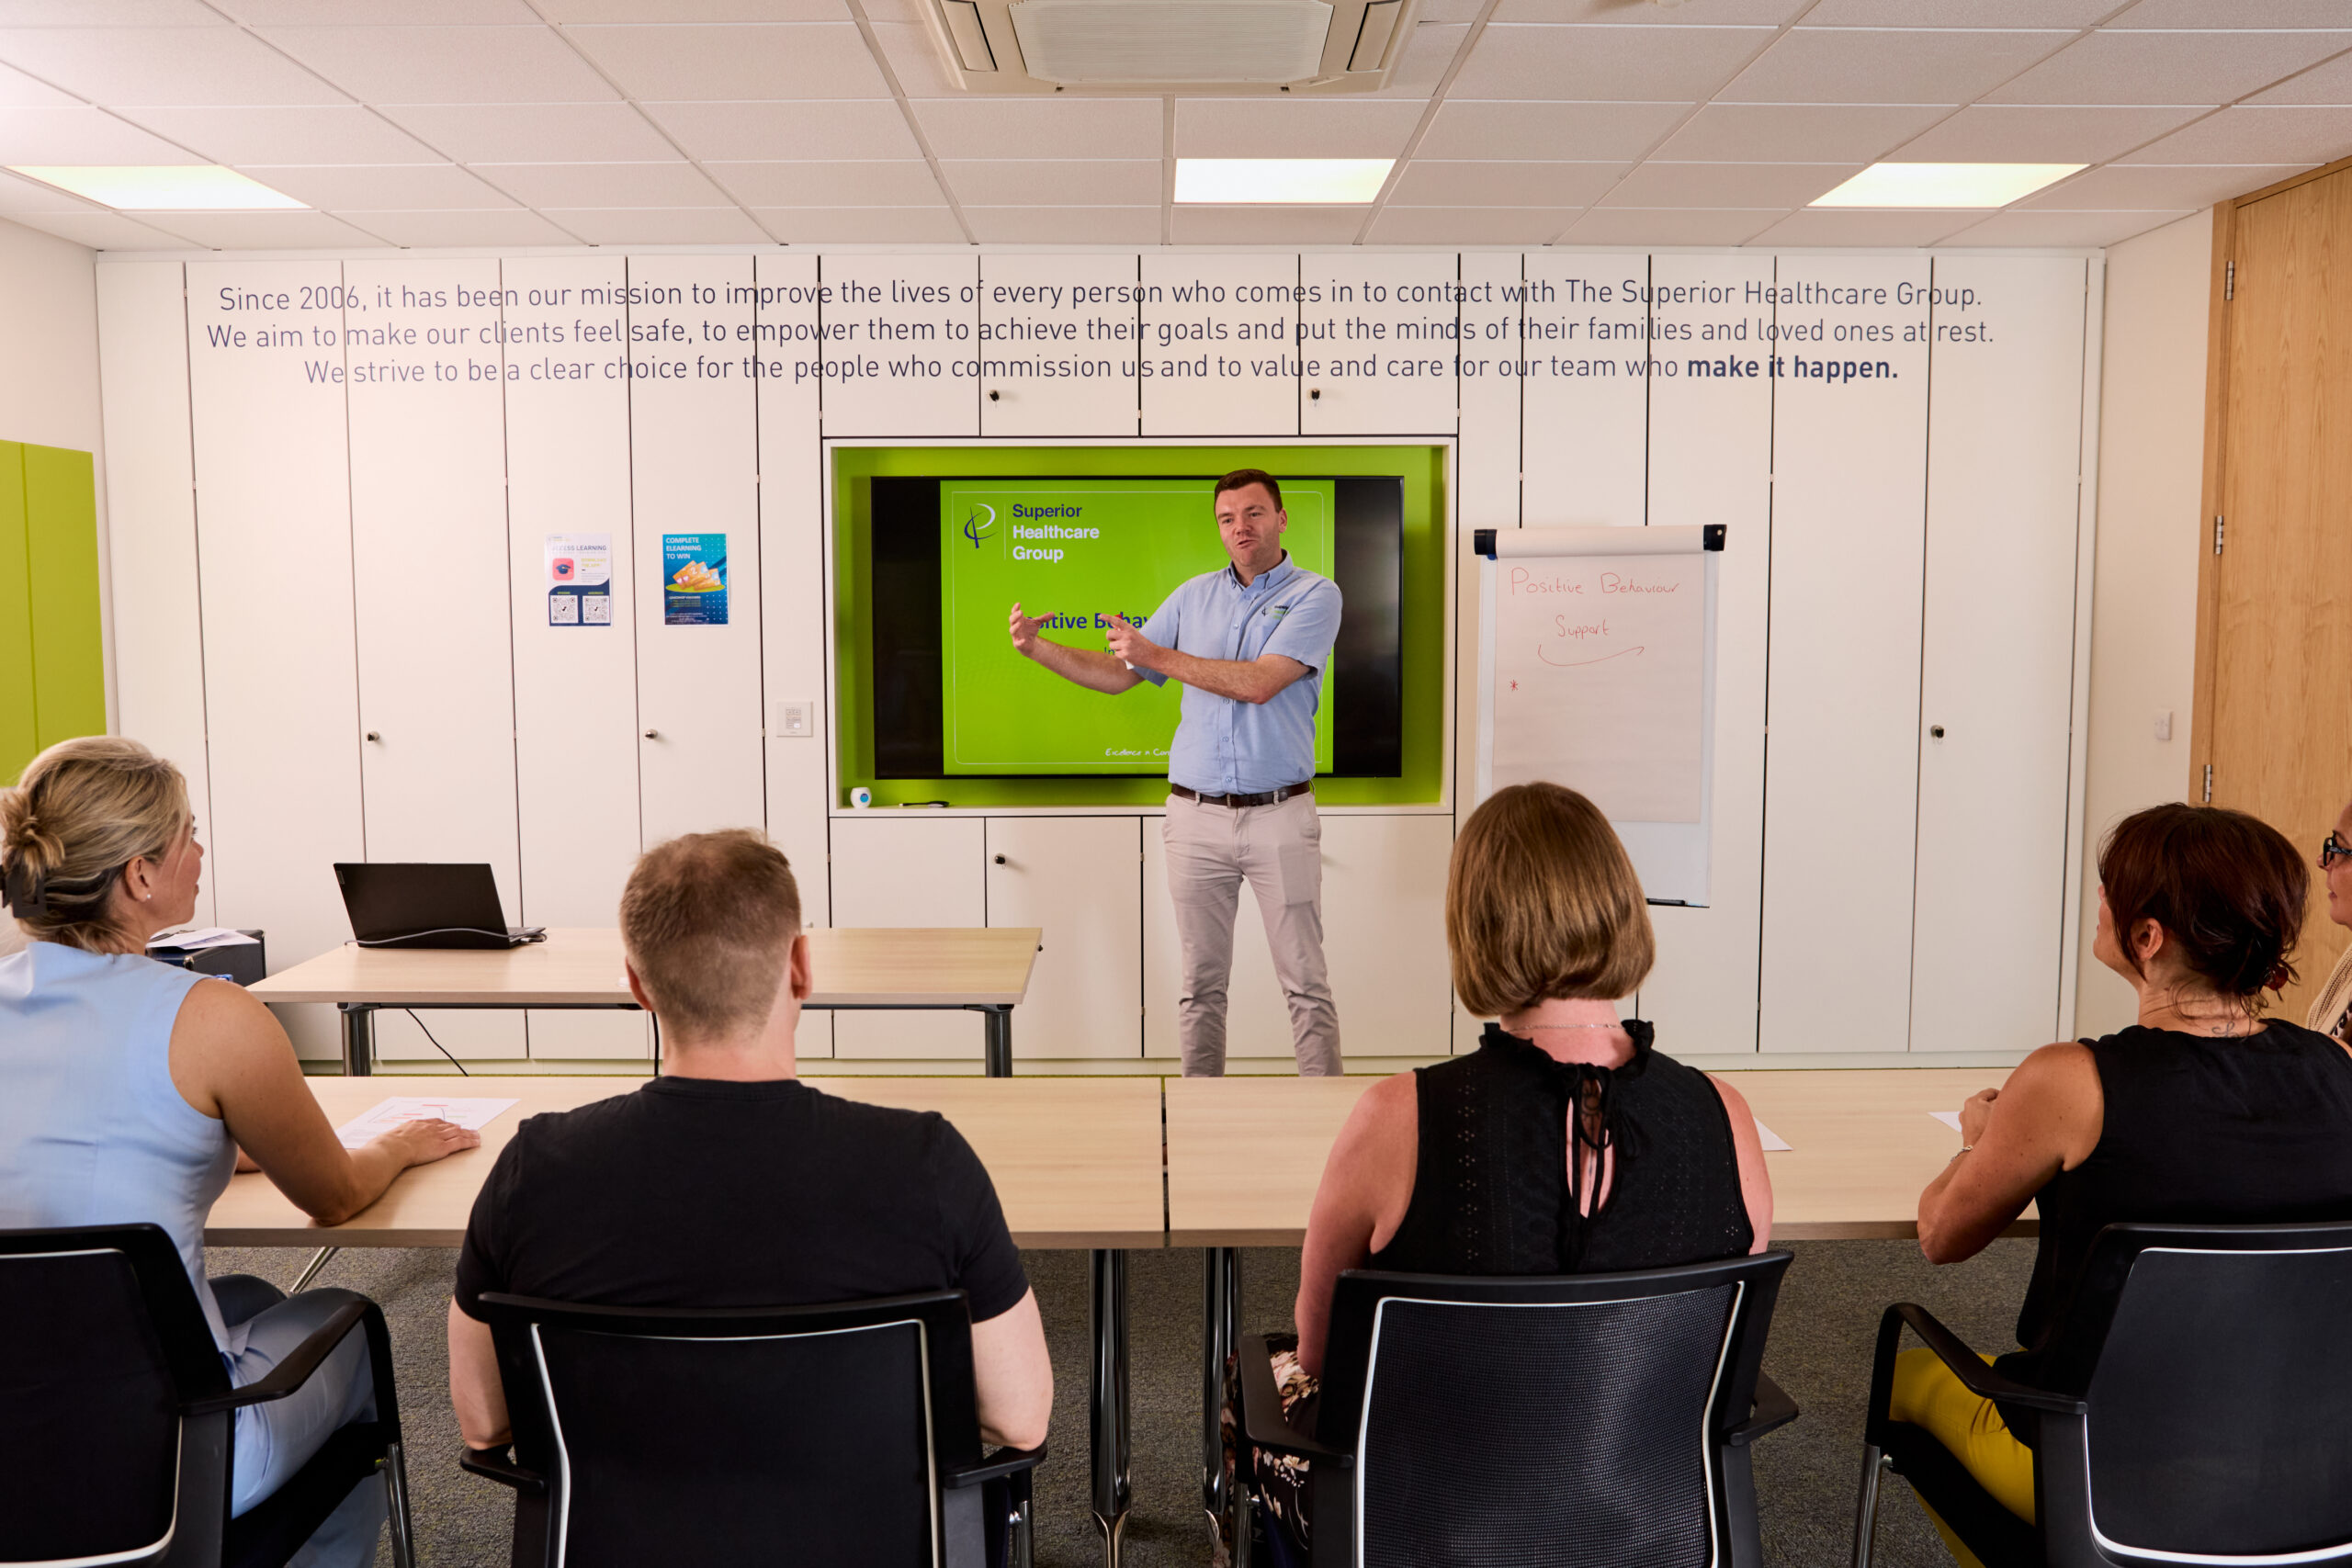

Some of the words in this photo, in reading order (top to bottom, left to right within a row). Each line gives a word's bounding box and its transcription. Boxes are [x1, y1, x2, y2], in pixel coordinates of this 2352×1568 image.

[219, 286, 290, 310] Since
[299, 285, 368, 312] 2006,
[377, 283, 392, 309] it
[401, 283, 447, 309] has
[456, 282, 519, 308] been
[527, 289, 571, 307] our
[581, 280, 683, 306] mission
[691, 283, 717, 305] to
[725, 278, 833, 310] improve
[841, 278, 882, 304] the
[891, 277, 951, 303] lives
[959, 277, 985, 303] of
[992, 286, 1063, 309] every
[1072, 286, 1164, 309] person
[1171, 277, 1226, 303] who
[1234, 286, 1322, 303] comes
[1331, 277, 1354, 303] in
[1362, 281, 1387, 303] to
[1396, 281, 1493, 303] contact
[1501, 278, 1555, 304] with
[1566, 278, 1612, 304] The
[1622, 279, 1736, 310] Superior
[1745, 279, 1887, 305] Healthcare
[1896, 281, 1982, 311] Group.
[207, 323, 247, 348] We
[255, 321, 304, 347] aim
[311, 325, 337, 347] to
[345, 321, 417, 346] make
[426, 328, 470, 345] our
[479, 319, 565, 344] clients
[573, 318, 623, 344] feel
[630, 317, 694, 345] safe,
[702, 321, 728, 343] to
[736, 324, 860, 347] empower
[867, 315, 935, 341] them
[944, 319, 969, 341] to
[978, 315, 1078, 341] achieve
[1087, 315, 1153, 341] their
[1158, 315, 1228, 346] goals
[1238, 315, 1285, 341] and
[1296, 319, 1337, 346] put
[1345, 315, 1386, 341] the
[1396, 315, 1476, 341] minds
[1485, 315, 1510, 341] of
[1519, 315, 1581, 341] their
[1588, 316, 1692, 342] families
[1702, 316, 1748, 342] and
[1757, 317, 1825, 343] loved
[1833, 325, 1894, 343] ones
[1904, 321, 1928, 343] at
[1937, 321, 1994, 343] rest.
[304, 359, 345, 384] We
[353, 357, 425, 383] strive
[434, 360, 459, 382] to
[468, 356, 498, 382] be
[505, 364, 520, 381] a
[529, 355, 595, 380] clear
[603, 354, 687, 379] choice
[695, 353, 734, 378] for
[741, 353, 783, 378] the
[794, 352, 879, 383] people
[888, 352, 942, 378] who
[951, 352, 1112, 378] commission
[1122, 360, 1154, 378] us
[1160, 352, 1208, 378] and
[1216, 355, 1242, 378] to
[1250, 352, 1321, 378] value
[1329, 352, 1377, 378] and
[1386, 360, 1444, 378] care
[1453, 352, 1489, 378] for
[1498, 360, 1543, 378] our
[1550, 355, 1616, 378] team
[1624, 352, 1679, 378] who
[1686, 352, 1760, 378] make
[1768, 353, 1785, 378] it
[1793, 353, 1898, 384] happen.
[1012, 503, 1082, 521] Superior
[1012, 525, 1100, 540] Healthcare
[1012, 547, 1064, 563] Group
[1511, 568, 1585, 595] Positive
[1600, 572, 1679, 594] Behaviour
[1555, 615, 1610, 639] Support
